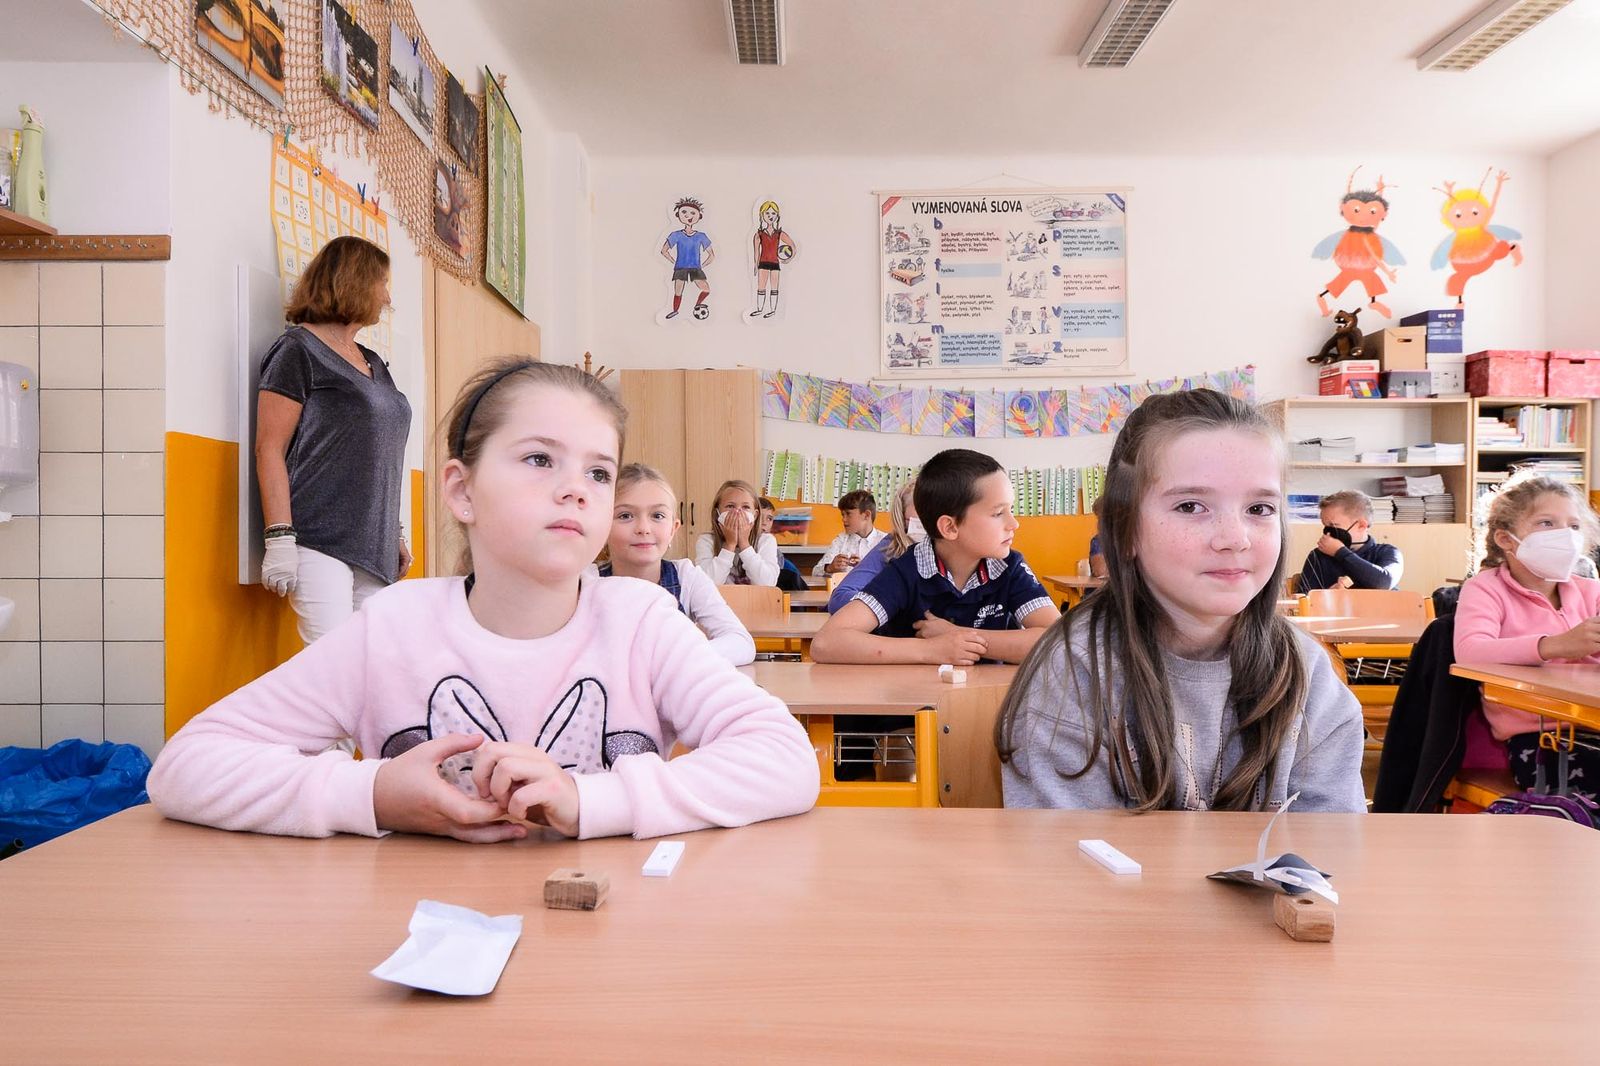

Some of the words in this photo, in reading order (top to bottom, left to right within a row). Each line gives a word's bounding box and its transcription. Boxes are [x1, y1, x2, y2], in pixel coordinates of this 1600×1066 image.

[912, 198, 988, 214] VYJMENOVANÁ
[991, 200, 1022, 213] SLOVA
[934, 217, 943, 230] b
[1053, 230, 1062, 242] p
[934, 258, 942, 272] f
[1052, 265, 1061, 277] s
[1052, 306, 1062, 318] v
[931, 324, 944, 334] m
[1052, 341, 1063, 353] z
